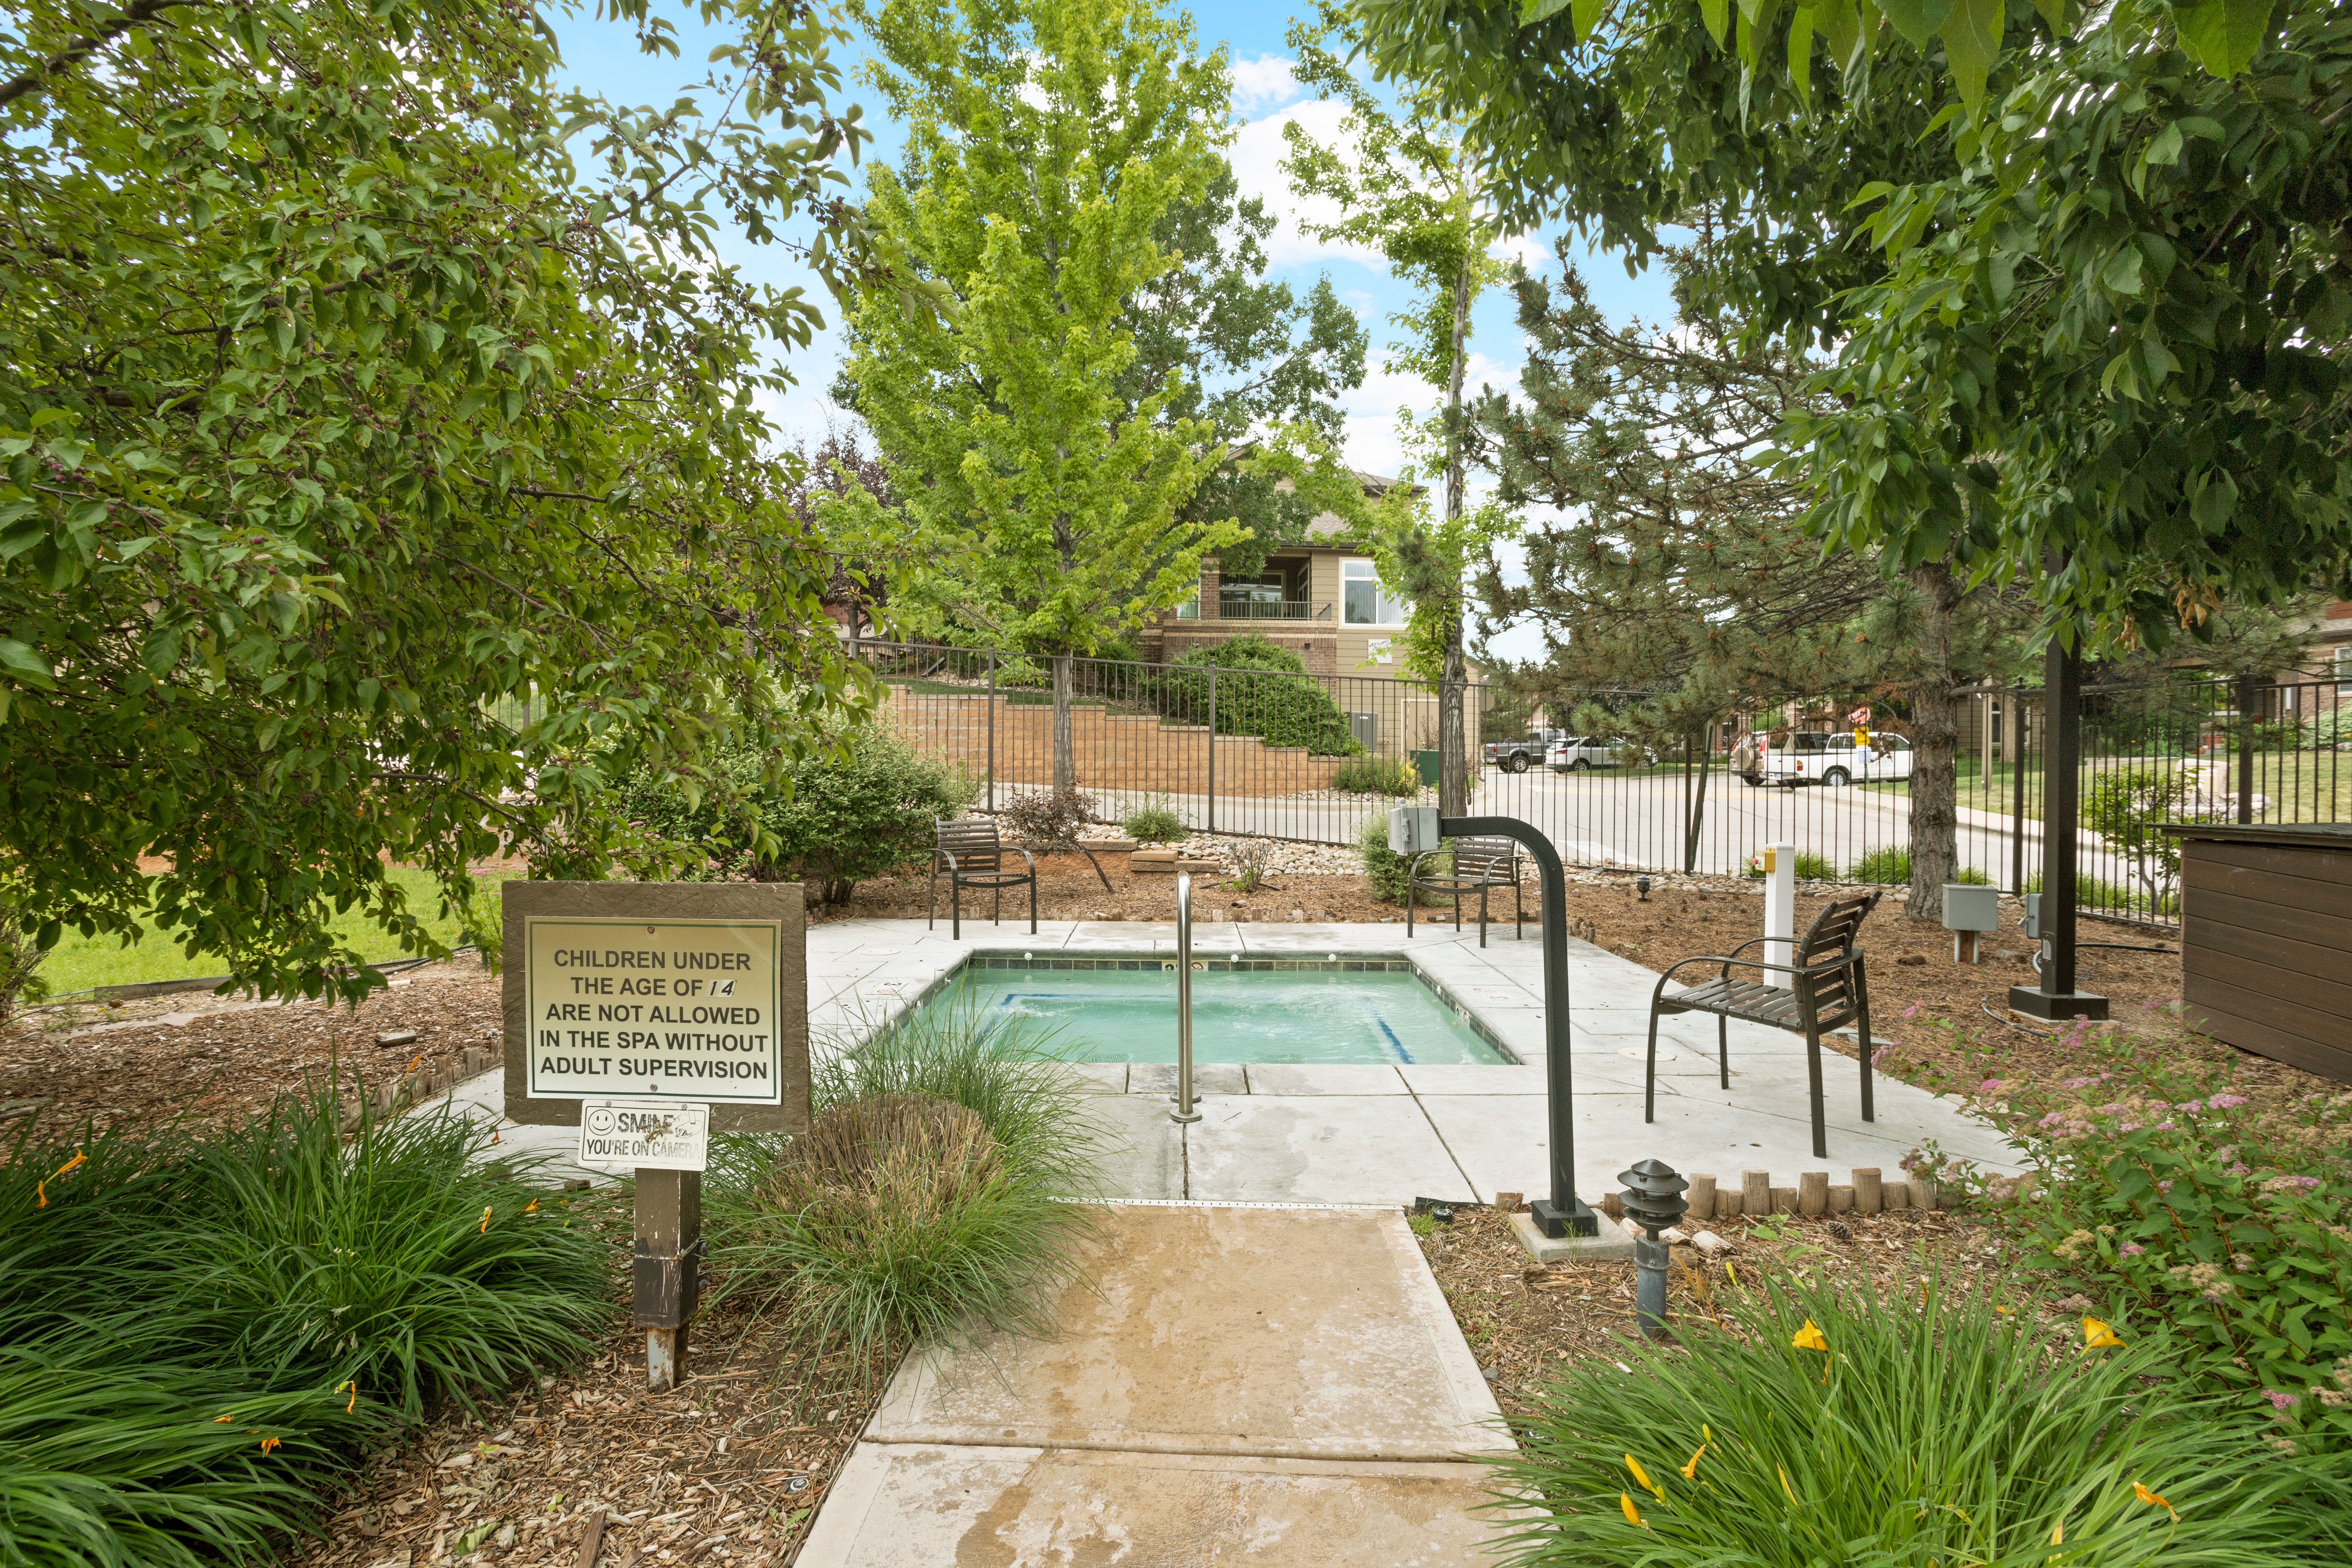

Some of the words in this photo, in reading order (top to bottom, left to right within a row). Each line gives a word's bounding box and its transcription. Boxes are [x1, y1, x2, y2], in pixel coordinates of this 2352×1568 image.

[554, 949, 665, 969] CHILDREN
[674, 952, 751, 971] UNDER
[570, 977, 614, 995] THE
[619, 978, 666, 996] AGE
[674, 979, 703, 996] OF
[710, 981, 734, 996] 14
[545, 1003, 591, 1021] ARE
[599, 1004, 643, 1022] NOT
[649, 1006, 760, 1025] ALLOWED
[540, 1030, 560, 1047] IN
[567, 1031, 610, 1048] THE
[617, 1032, 660, 1049] SPA
[665, 1033, 768, 1052] WITHOUT
[540, 1057, 612, 1075] ADULT
[619, 1058, 767, 1079] SUPERVISION
[586, 1139, 629, 1155] YOU'RE
[632, 1141, 649, 1156] ON
[652, 1141, 700, 1159] CAMERA
